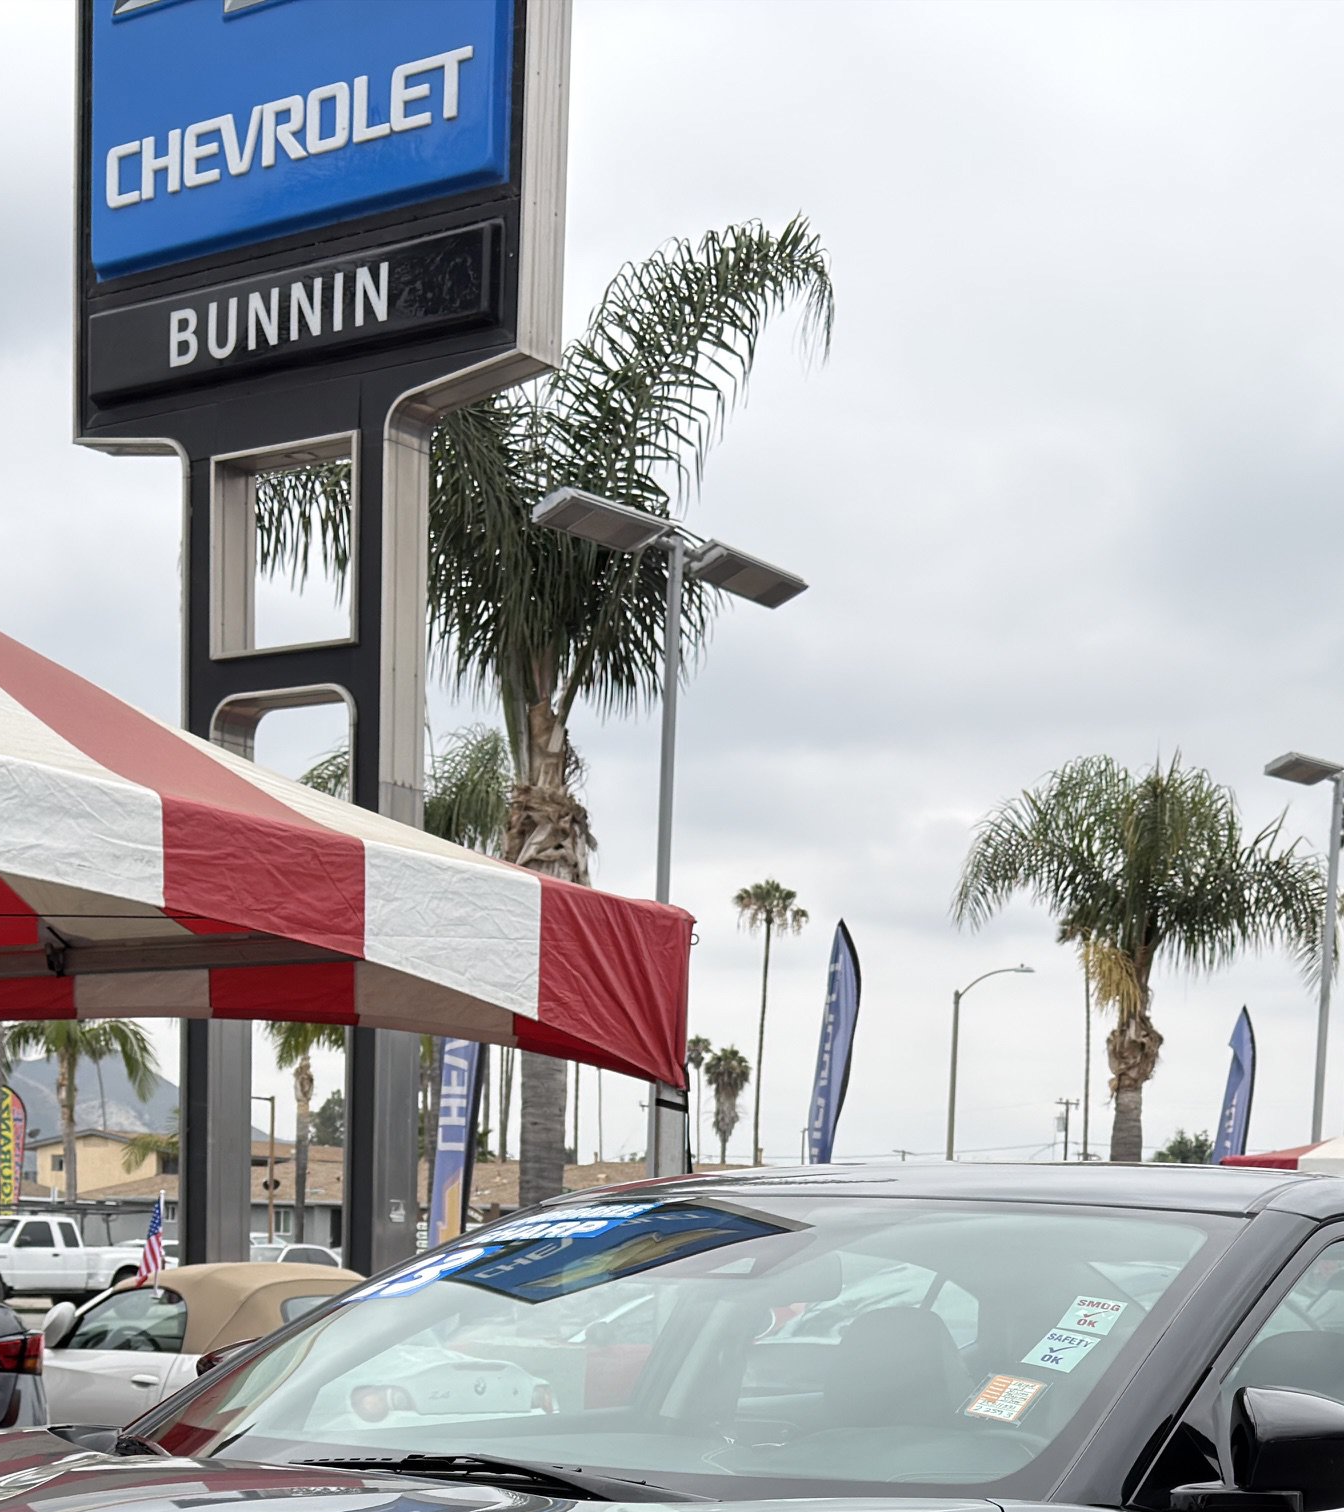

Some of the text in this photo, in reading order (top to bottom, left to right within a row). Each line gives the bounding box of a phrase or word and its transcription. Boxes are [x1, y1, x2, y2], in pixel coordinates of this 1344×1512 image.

[106, 45, 474, 209] CHEVROLET
[169, 261, 390, 368] BUNNIN
[1077, 1299, 1121, 1312] SMOG
[1077, 1318, 1098, 1328] OK
[1047, 1333, 1094, 1348] SAFETY
[1040, 1354, 1064, 1365] OK
